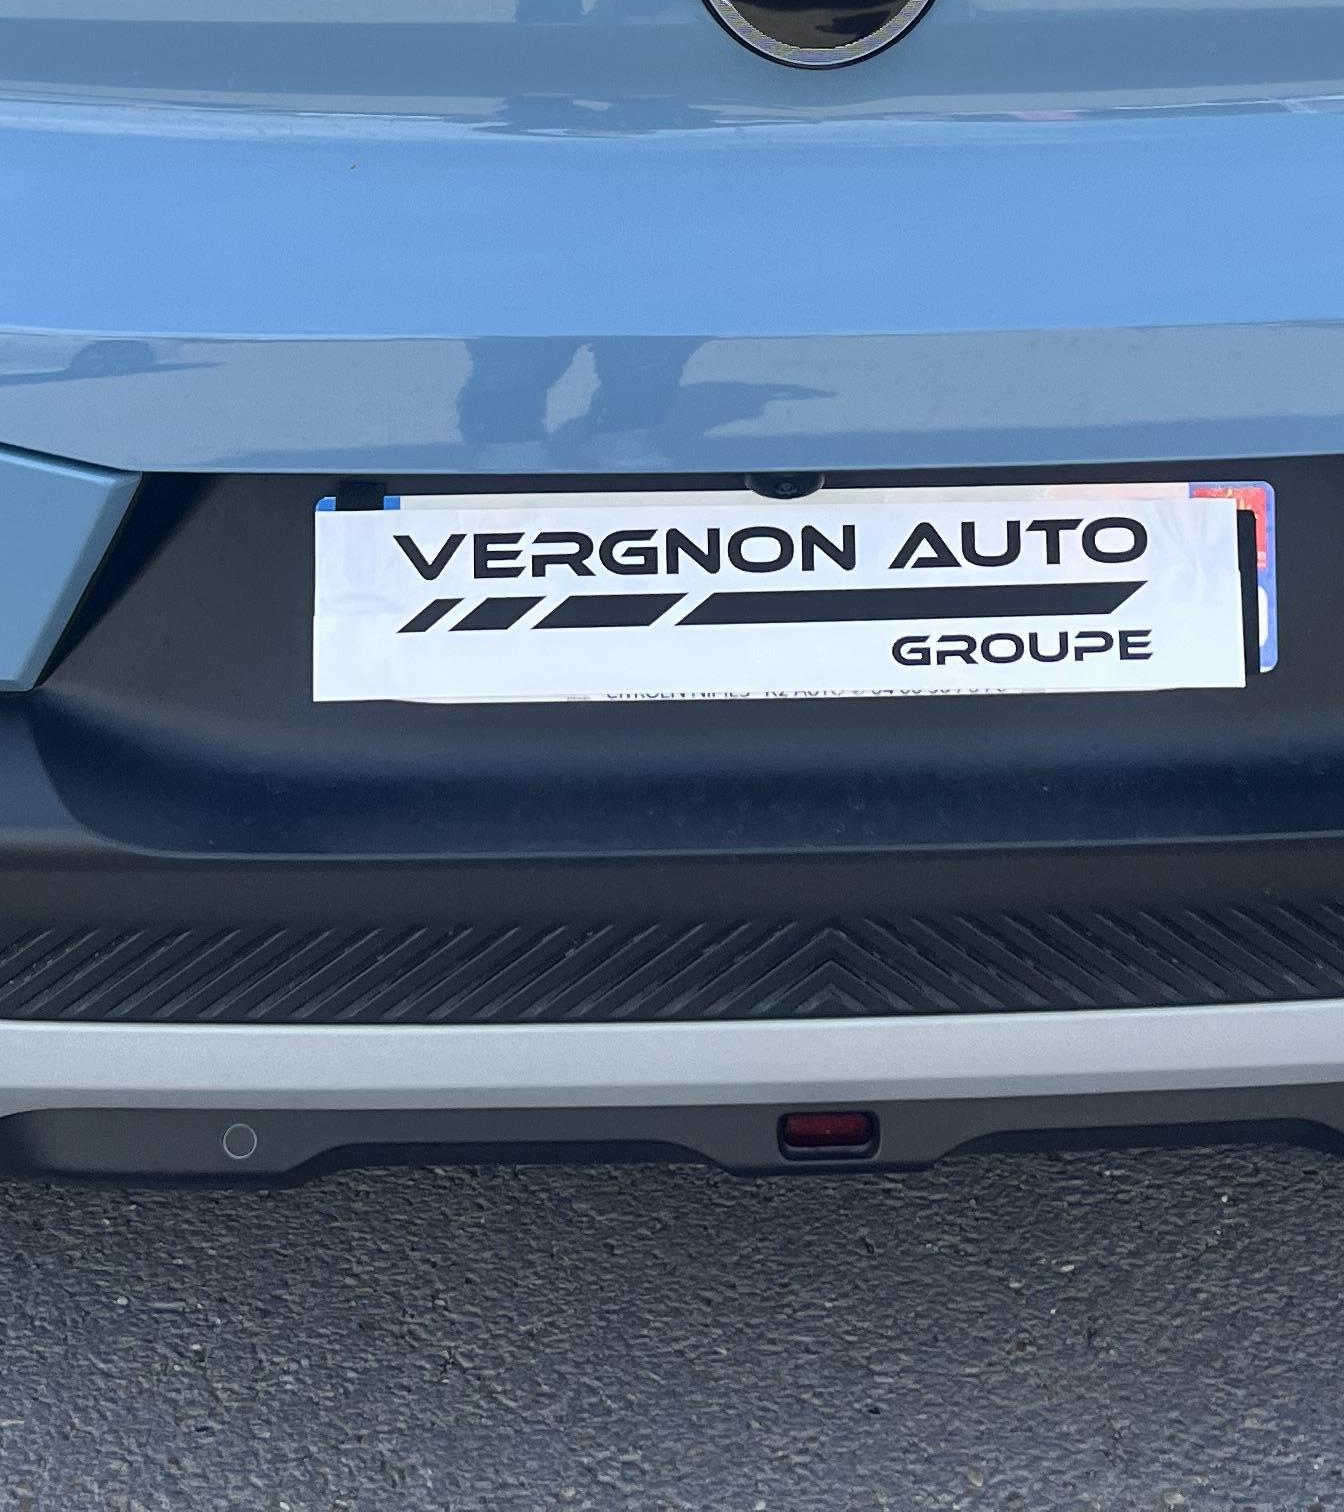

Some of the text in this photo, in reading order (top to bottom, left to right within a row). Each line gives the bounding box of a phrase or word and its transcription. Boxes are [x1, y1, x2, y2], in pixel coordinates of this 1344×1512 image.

[392, 516, 1148, 581] VERGNON AUTO
[891, 629, 1154, 667] GROUPE
